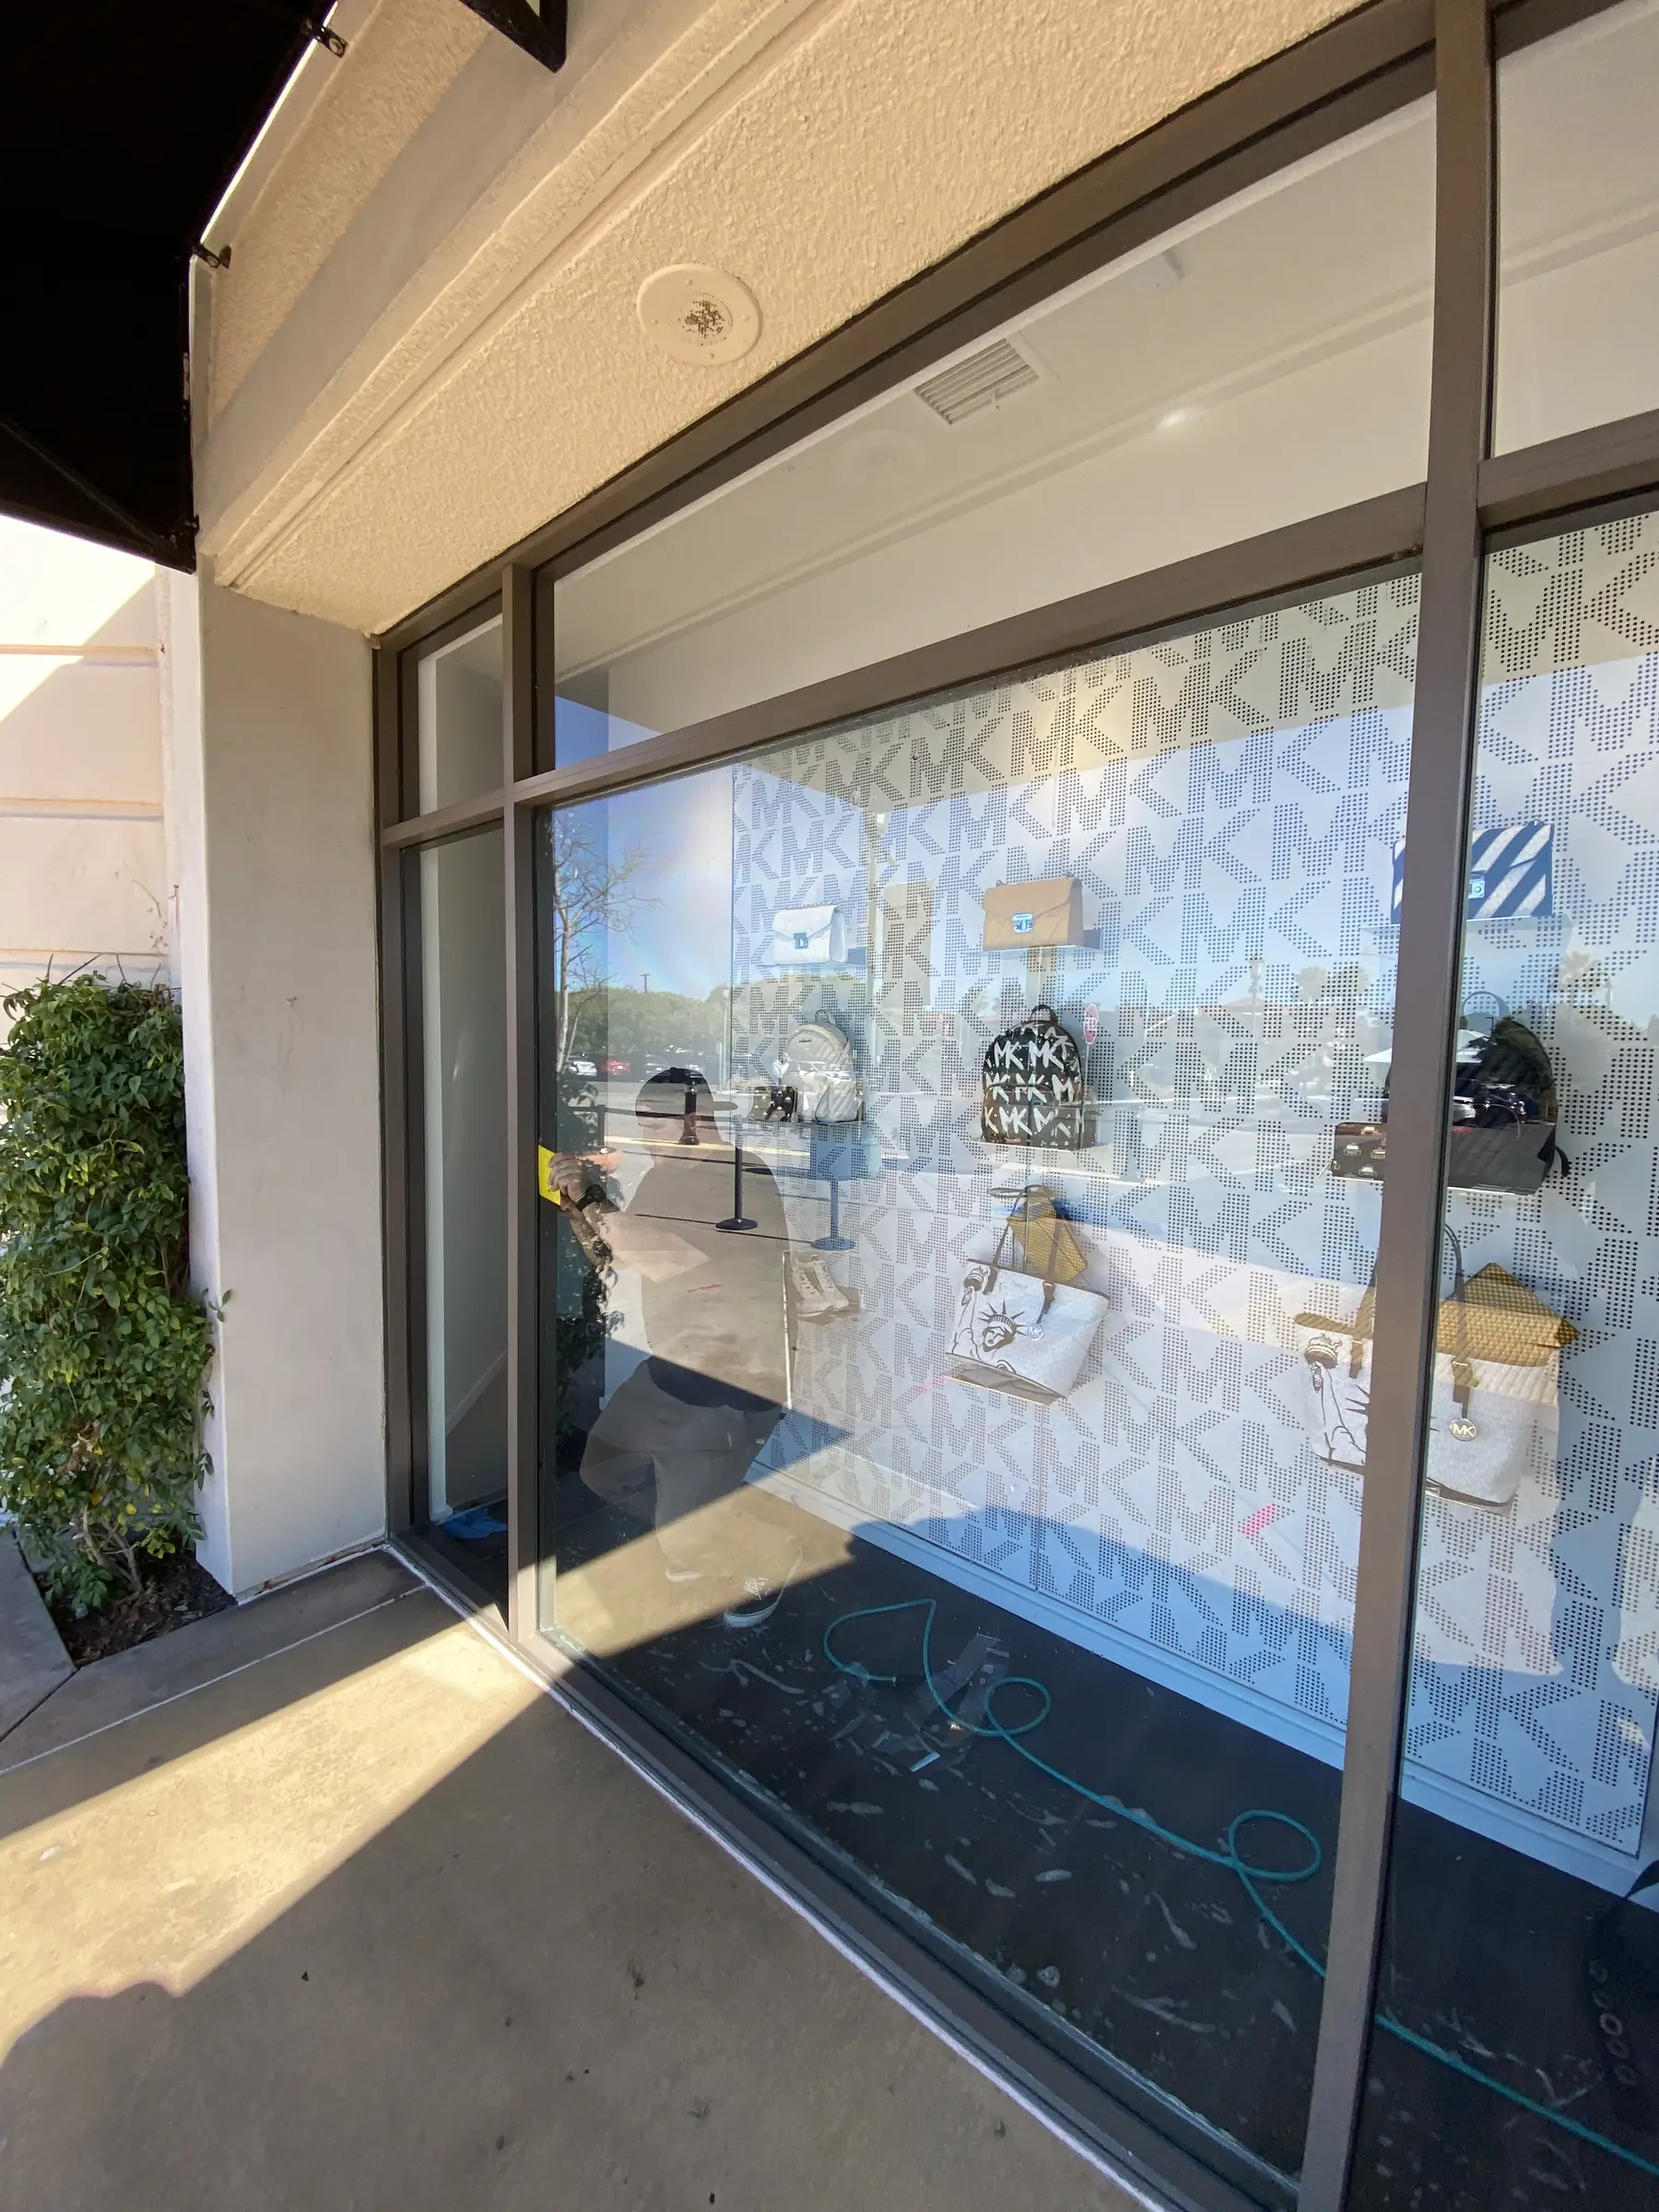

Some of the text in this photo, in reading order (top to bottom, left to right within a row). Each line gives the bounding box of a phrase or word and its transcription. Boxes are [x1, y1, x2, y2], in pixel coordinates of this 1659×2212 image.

[752, 764, 821, 830] MK
[825, 743, 906, 816] MK
[911, 717, 1006, 798] MK
[1011, 685, 1125, 777] MK
[1132, 646, 1273, 751] MK
[782, 813, 854, 877] MK
[858, 794, 945, 865] MK
[949, 772, 1052, 852] MK
[1057, 746, 1182, 835] MK
[1187, 712, 1341, 815] MK
[1545, 644, 1658, 757] M
[907, 848, 1002, 918] MK
[1125, 807, 1265, 896] MK
[1181, 879, 1332, 964] MK
[1119, 965, 1256, 1038] MK
[994, 1040, 1065, 1070] MK MK
[1015, 1073, 1047, 1103] MK
[1173, 1041, 1324, 1119] MK
[999, 1106, 1032, 1135] MK
[1113, 1110, 1249, 1191] MK
[1167, 1185, 1315, 1277] MK
[1108, 1247, 1241, 1340] MK
[1161, 1326, 1307, 1432] MK
[1102, 1380, 1234, 1486] MK
[1453, 1423, 1475, 1437] MK
[1097, 1511, 1228, 1629] MK
